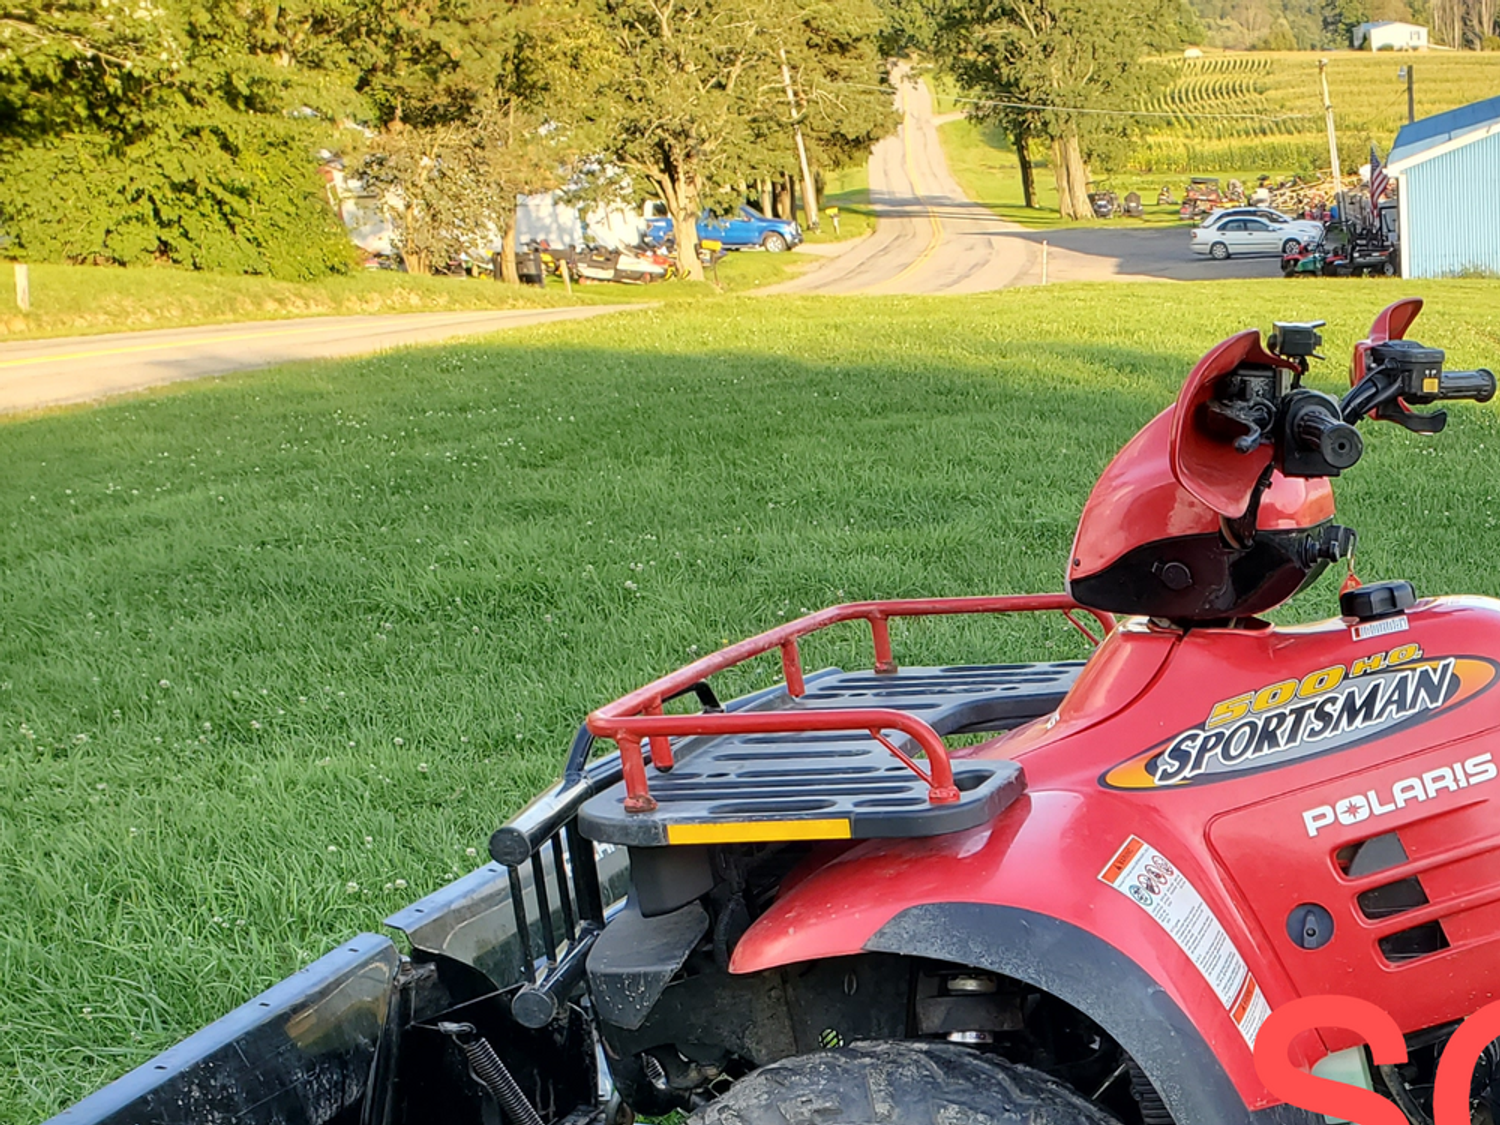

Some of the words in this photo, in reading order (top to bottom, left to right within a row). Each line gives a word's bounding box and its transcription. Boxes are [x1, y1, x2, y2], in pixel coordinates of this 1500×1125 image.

[1155, 658, 1455, 786] SPORTSMAN
[1206, 665, 1346, 730] 500
[1350, 643, 1423, 677] H.O.
[1302, 753, 1499, 837] POLARIS
